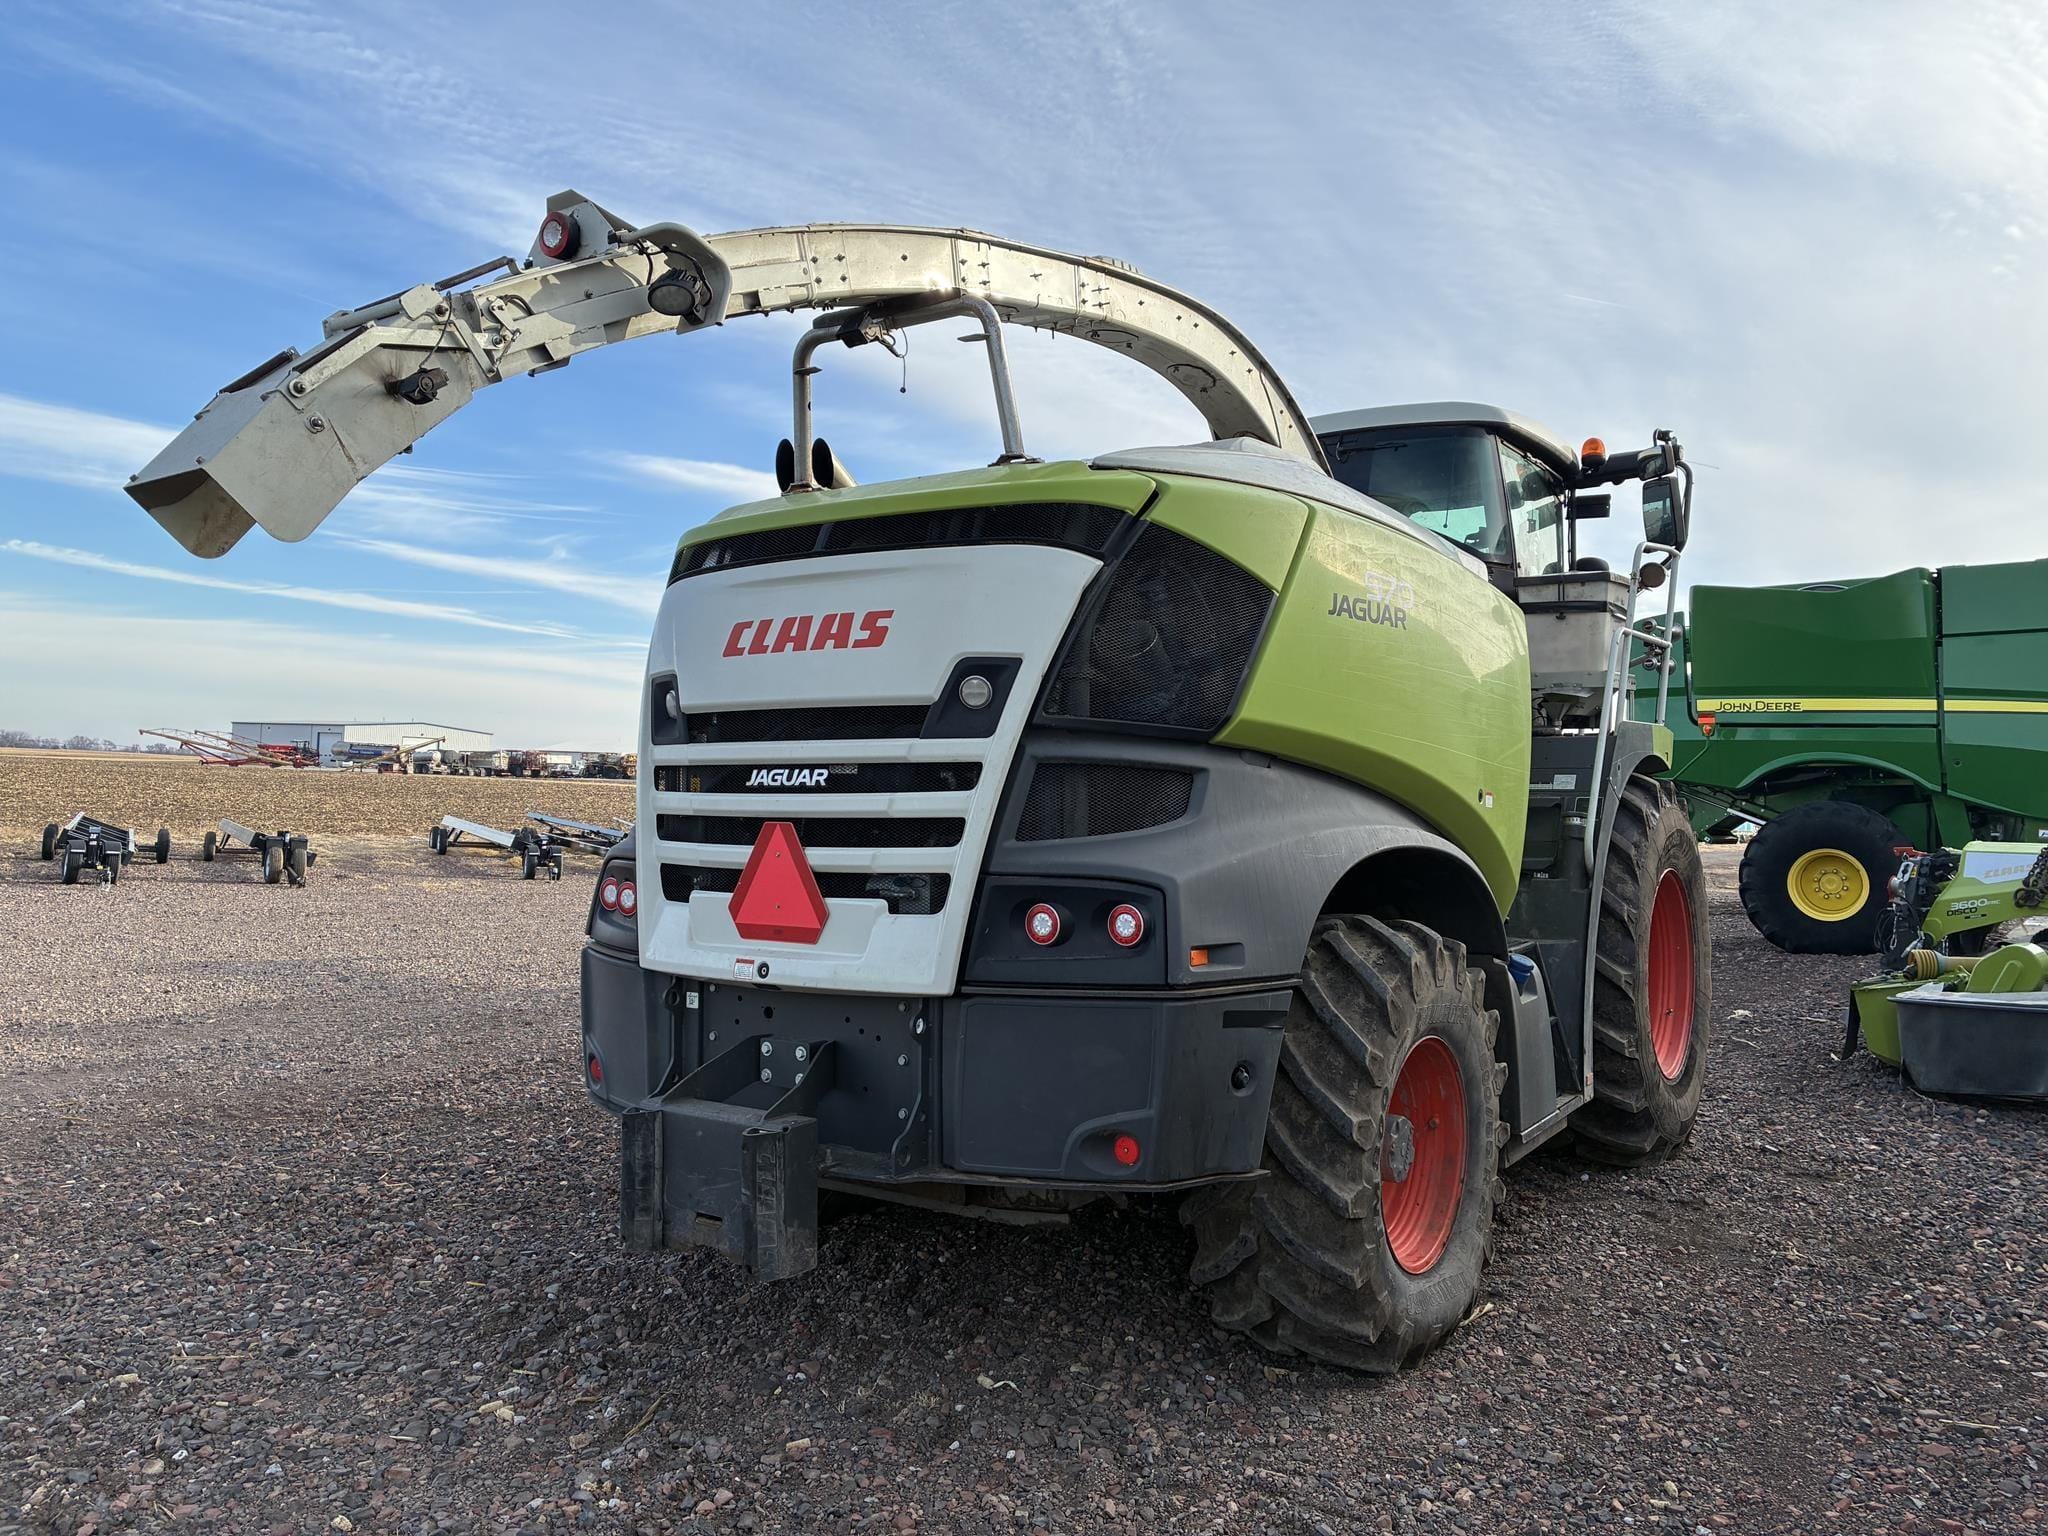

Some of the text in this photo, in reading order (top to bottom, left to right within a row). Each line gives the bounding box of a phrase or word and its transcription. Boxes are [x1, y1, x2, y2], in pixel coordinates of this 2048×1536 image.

[1328, 592, 1407, 631] JAGUAR
[722, 609, 895, 658] CLAAS
[1715, 701, 1802, 711] JOHN DEERE
[745, 768, 829, 786] JAGUAR
[1947, 907, 1977, 916] DISCO
[1951, 899, 1987, 910] 3600
